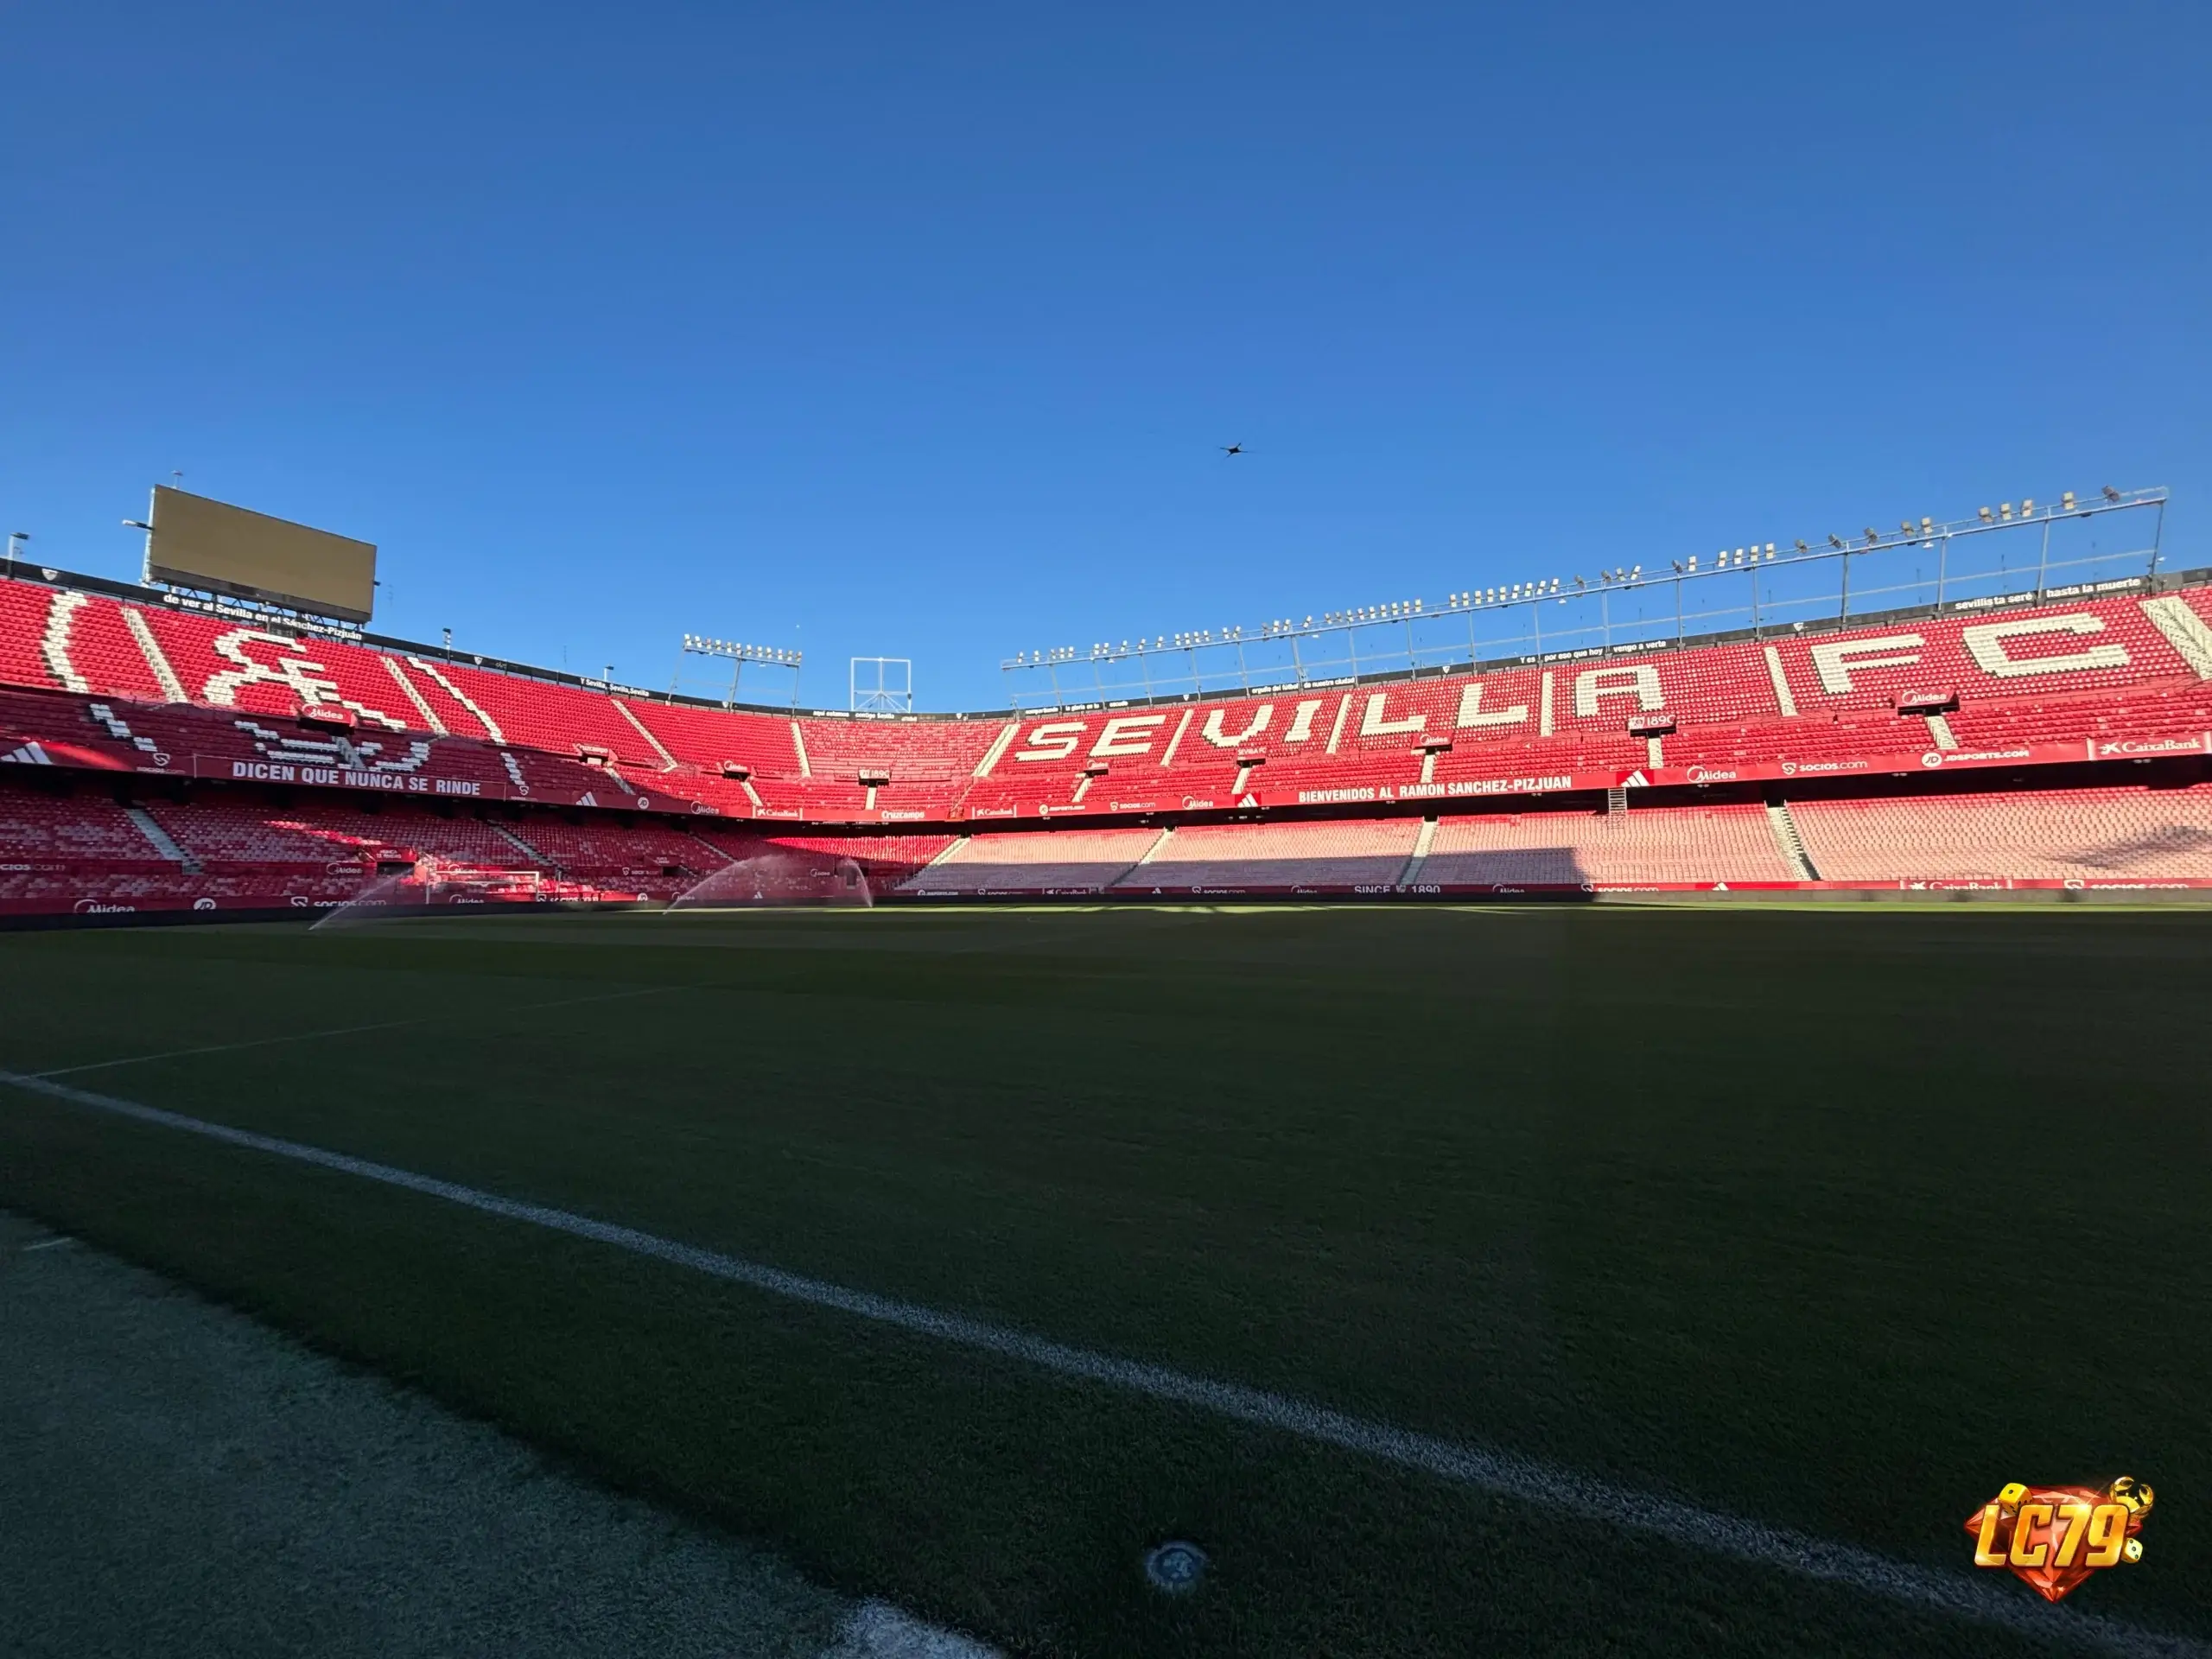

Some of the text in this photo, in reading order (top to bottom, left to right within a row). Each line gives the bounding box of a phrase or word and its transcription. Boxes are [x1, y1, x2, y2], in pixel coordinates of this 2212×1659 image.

[1955, 578, 2141, 610] sevillista seré hasta la muerte
[163, 593, 363, 640] de ver al Sevilla en el Sánchez-Pizjuán
[1573, 651, 1587, 659] que
[1589, 647, 1604, 656] hoy
[1613, 644, 1637, 652] vengo
[1015, 613, 2132, 762] SEVILLA FC
[1907, 692, 1948, 703] Midea
[307, 706, 344, 720] Midea
[2122, 739, 2201, 753] CaixaBank
[1945, 750, 2029, 761] JDSPORTS.COM
[232, 761, 481, 796] DICEN QUE NUNCA SE RINDE
[1299, 776, 1572, 803] BIENVENIDOS AL RAMON SANCHEZ-PIZJUAN
[881, 810, 925, 820] Cruzcampo
[1411, 885, 1441, 893] 1890
